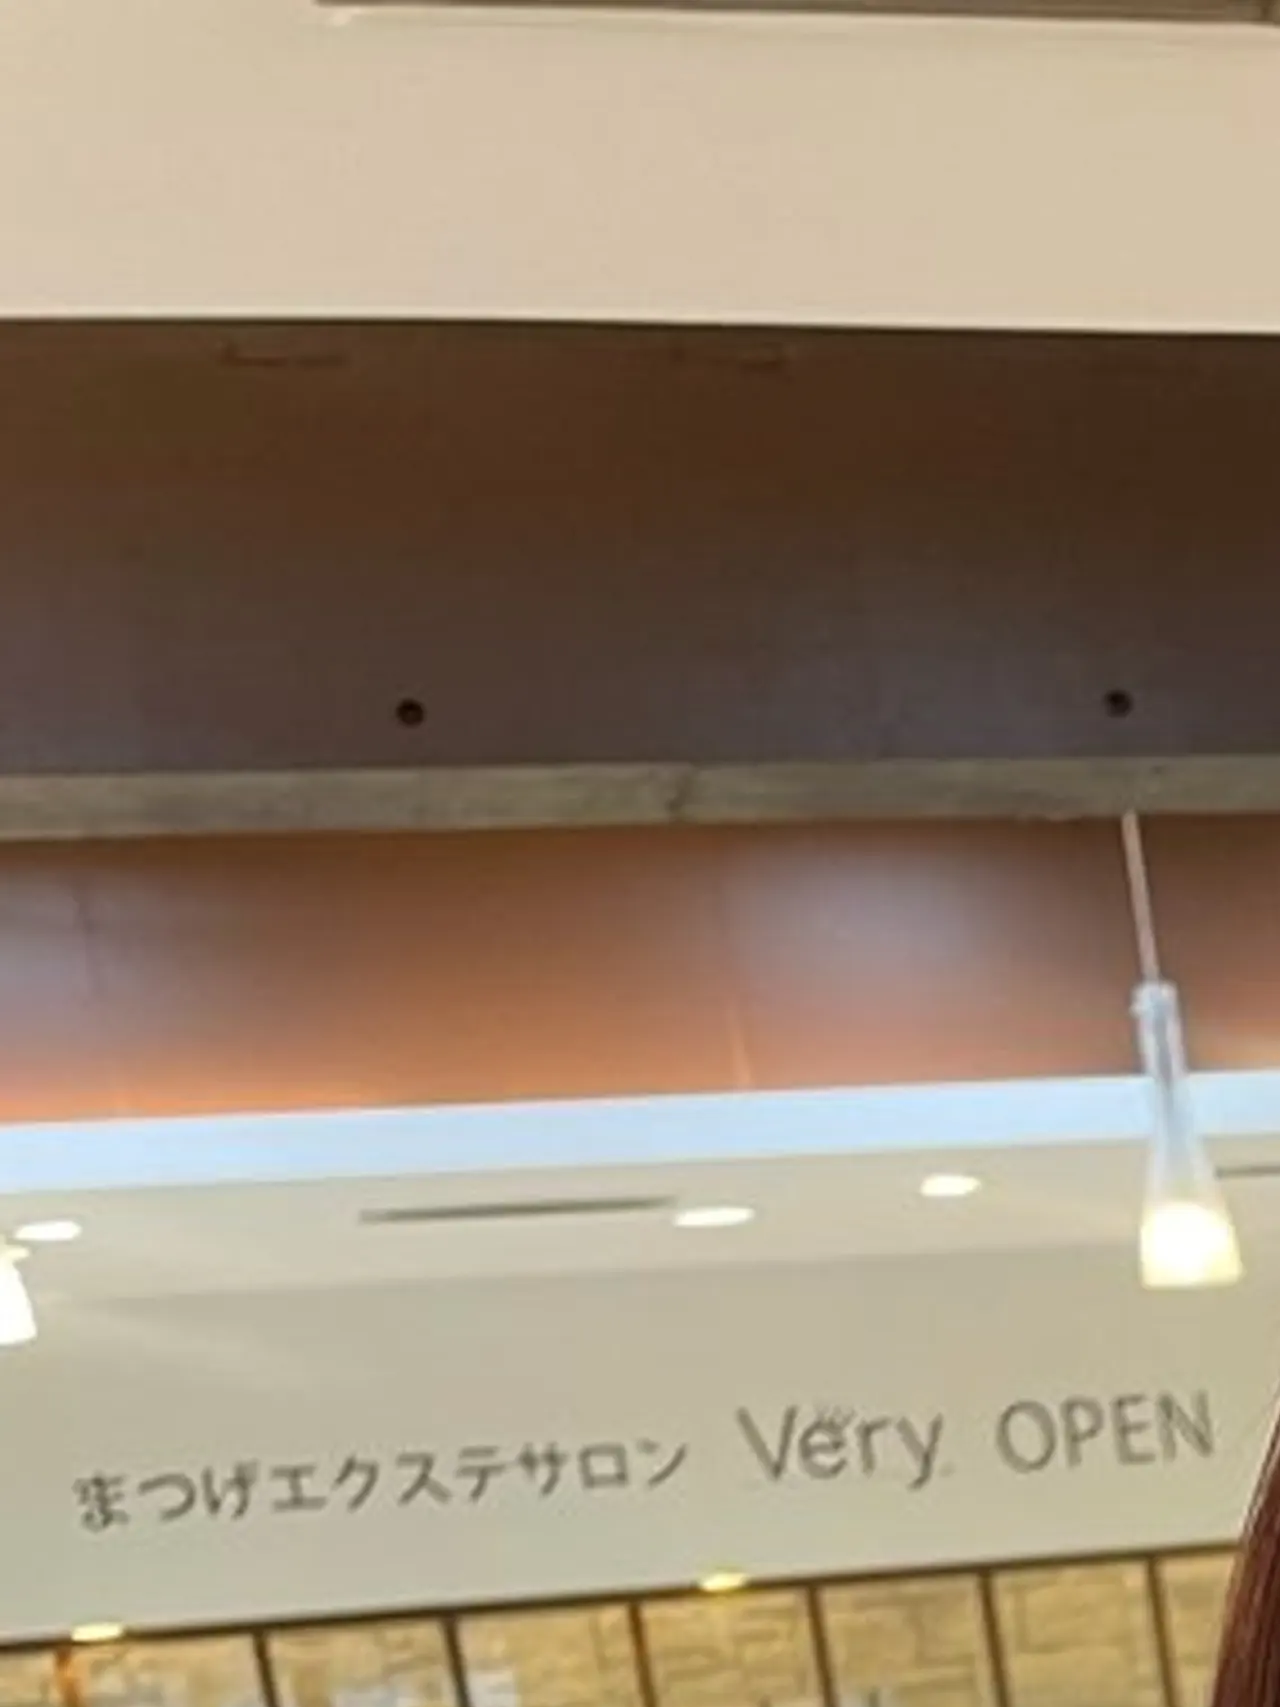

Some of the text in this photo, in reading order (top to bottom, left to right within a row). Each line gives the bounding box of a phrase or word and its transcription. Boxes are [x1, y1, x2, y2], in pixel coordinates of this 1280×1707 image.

[72, 1390, 1214, 1533] まつげエクステサロン Very OPEN
